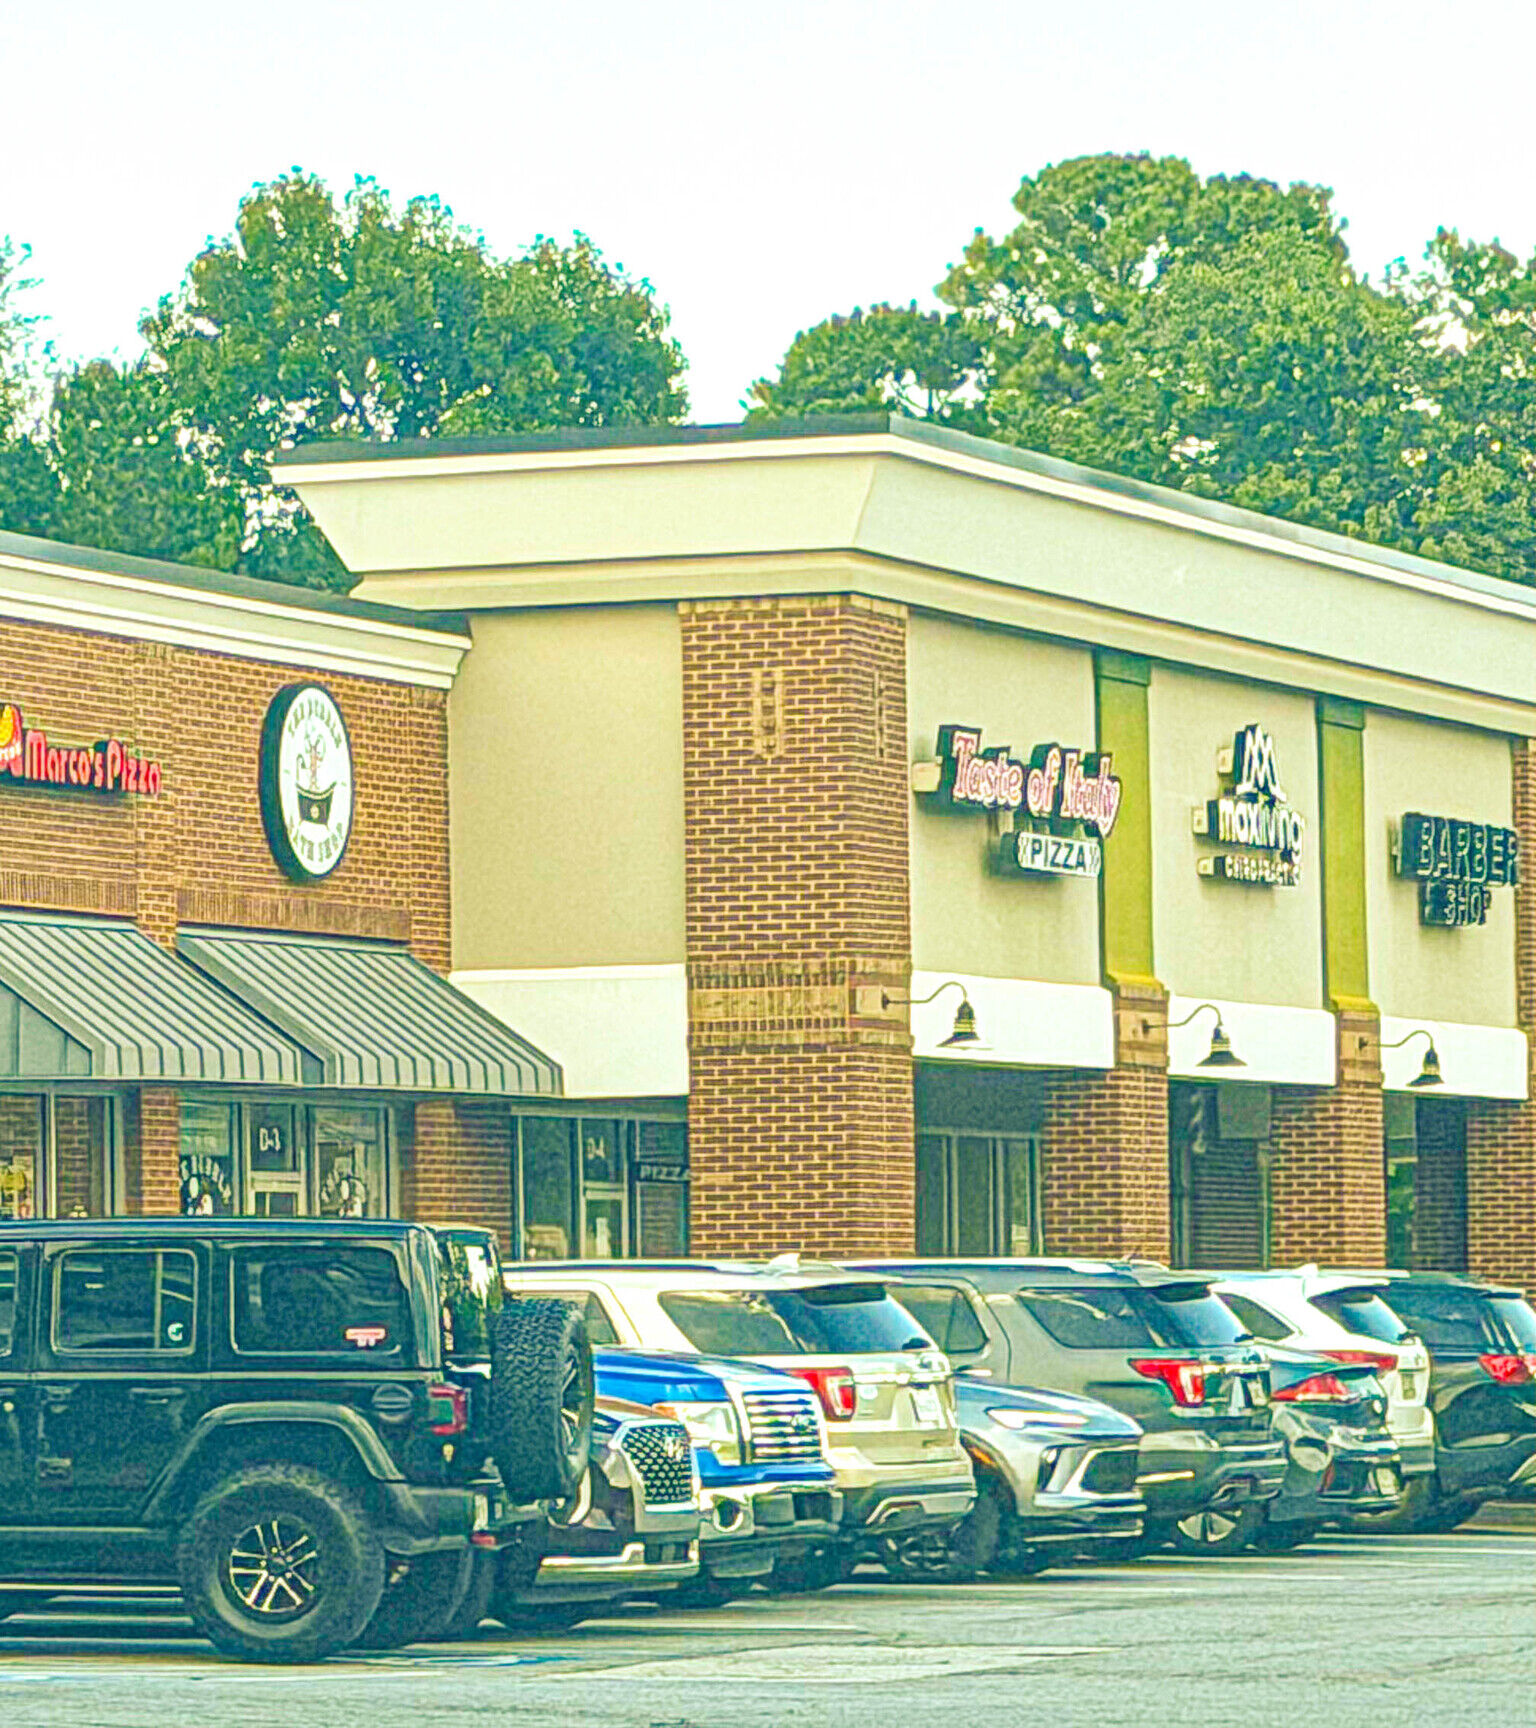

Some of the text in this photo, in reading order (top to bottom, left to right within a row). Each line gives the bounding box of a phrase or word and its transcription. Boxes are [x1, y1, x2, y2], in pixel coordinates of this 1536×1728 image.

[24, 729, 105, 788] Marco's
[106, 737, 162, 797] Pizza
[952, 730, 1024, 807] Taste
[1027, 748, 1062, 818] of
[1031, 838, 1086, 873] PIZZA
[1416, 818, 1521, 888] BARBER
